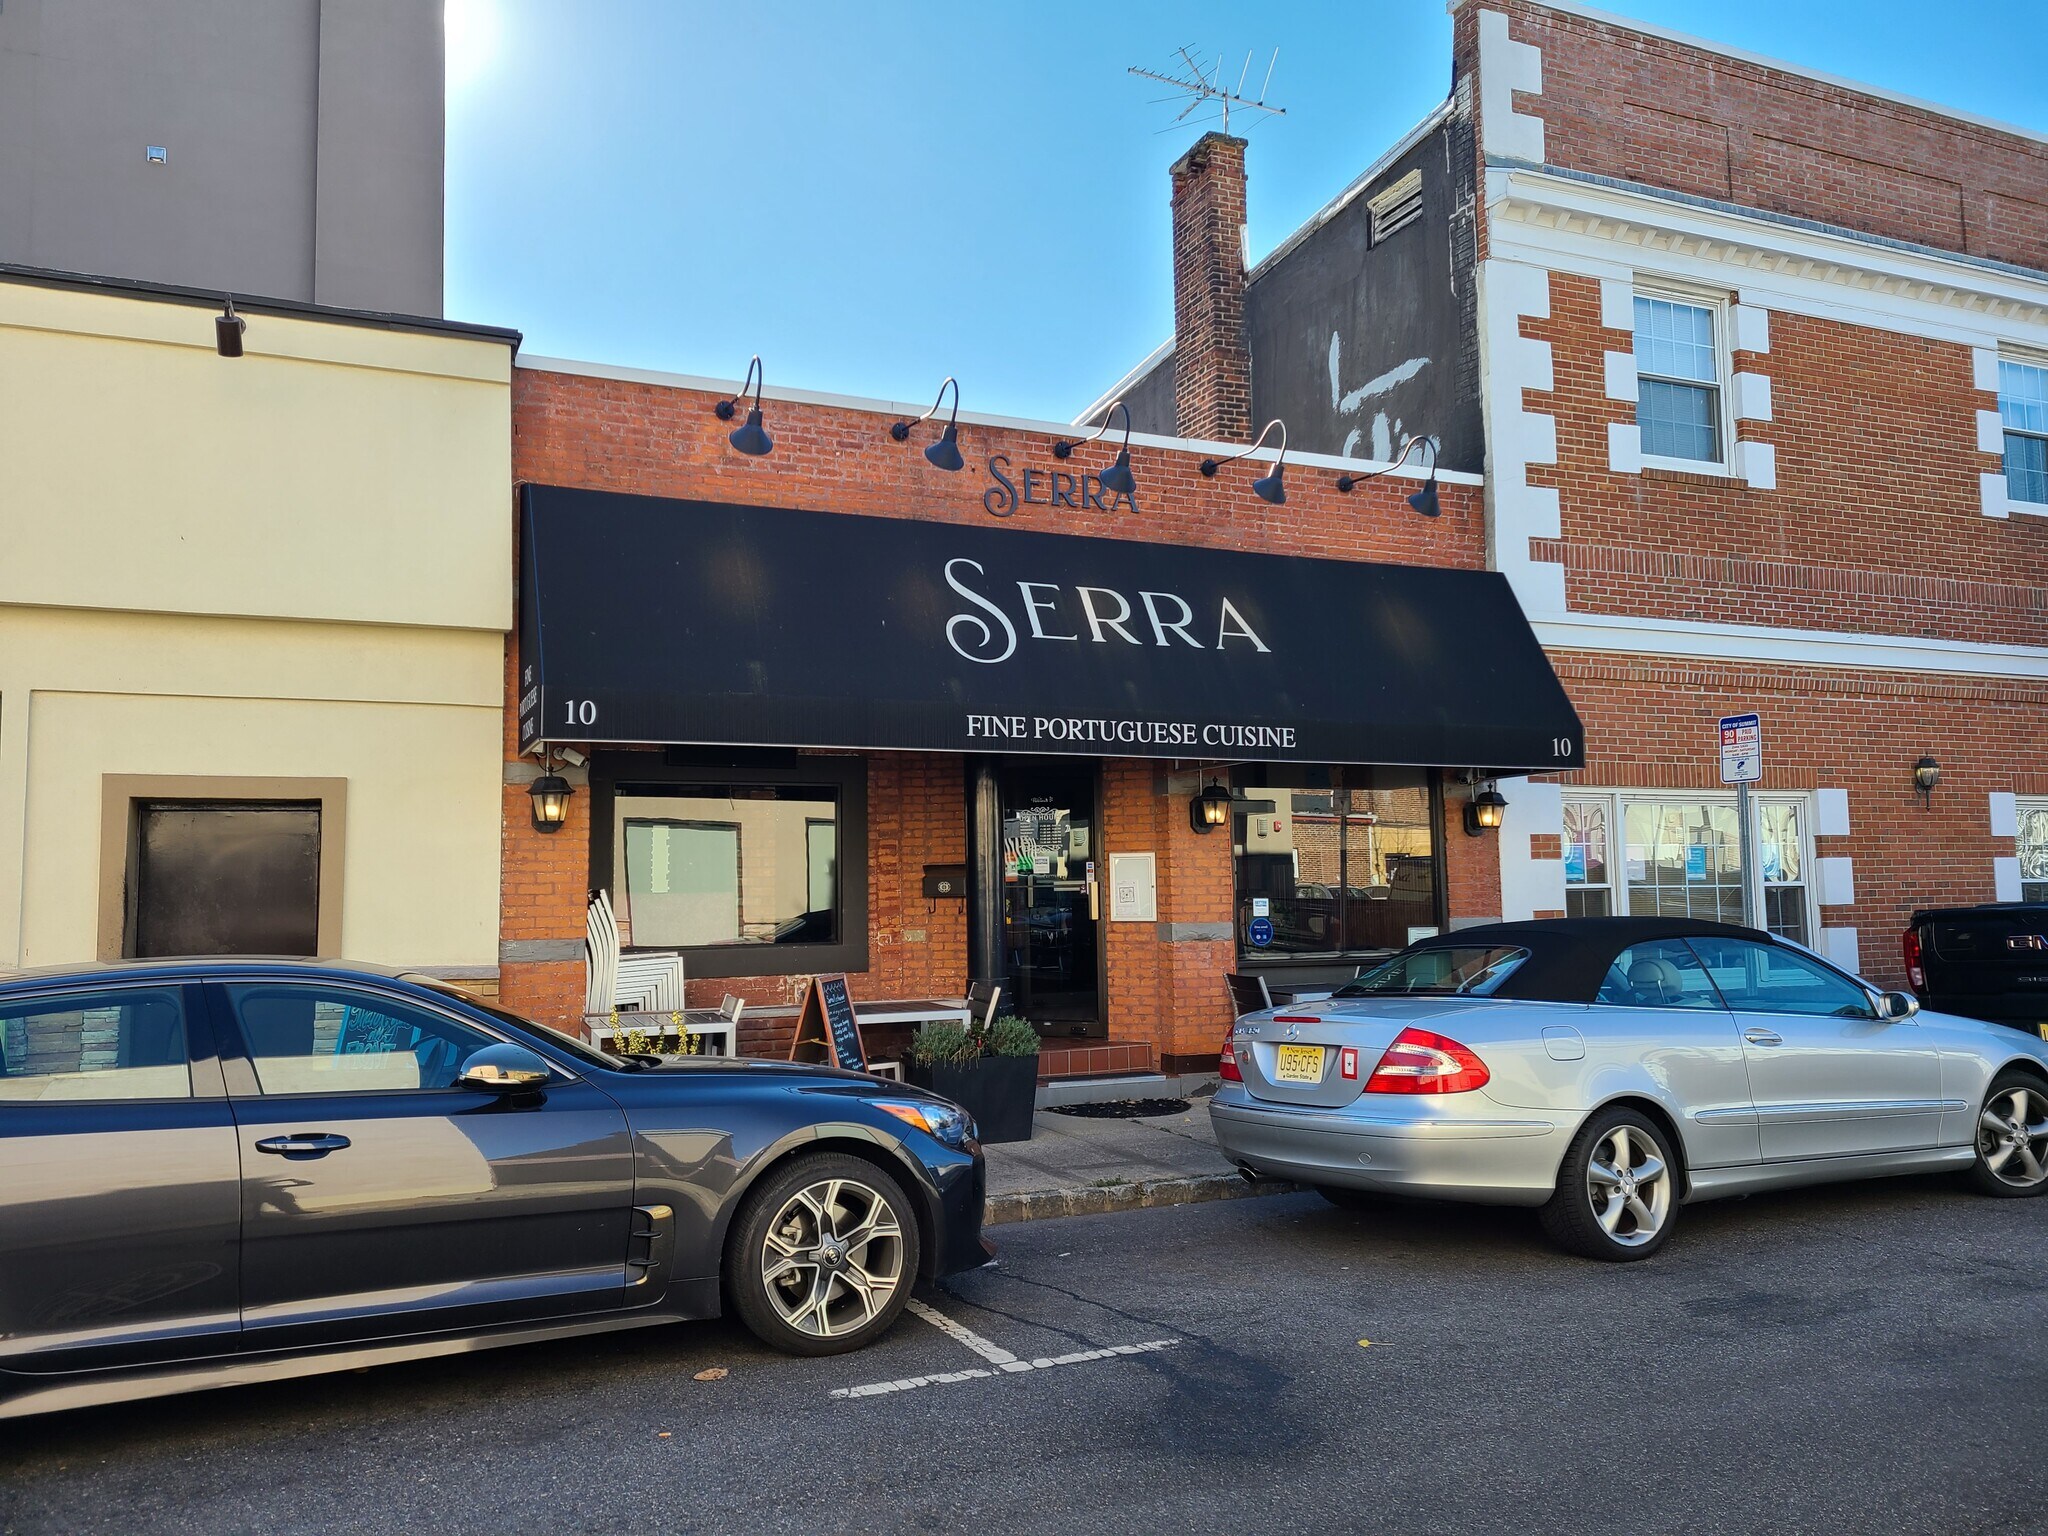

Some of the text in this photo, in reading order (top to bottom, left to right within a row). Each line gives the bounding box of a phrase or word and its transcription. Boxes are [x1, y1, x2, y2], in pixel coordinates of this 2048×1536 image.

[984, 455, 1140, 517] SERRA
[944, 558, 1272, 664] SERRA
[565, 699, 597, 725] 10
[1739, 719, 1757, 728] SUMMIT
[966, 714, 1297, 748] FINE PORTUGUESE CUISINE
[1724, 730, 1734, 738] 90
[1738, 734, 1756, 742] PARKING
[1552, 737, 1572, 757] 10
